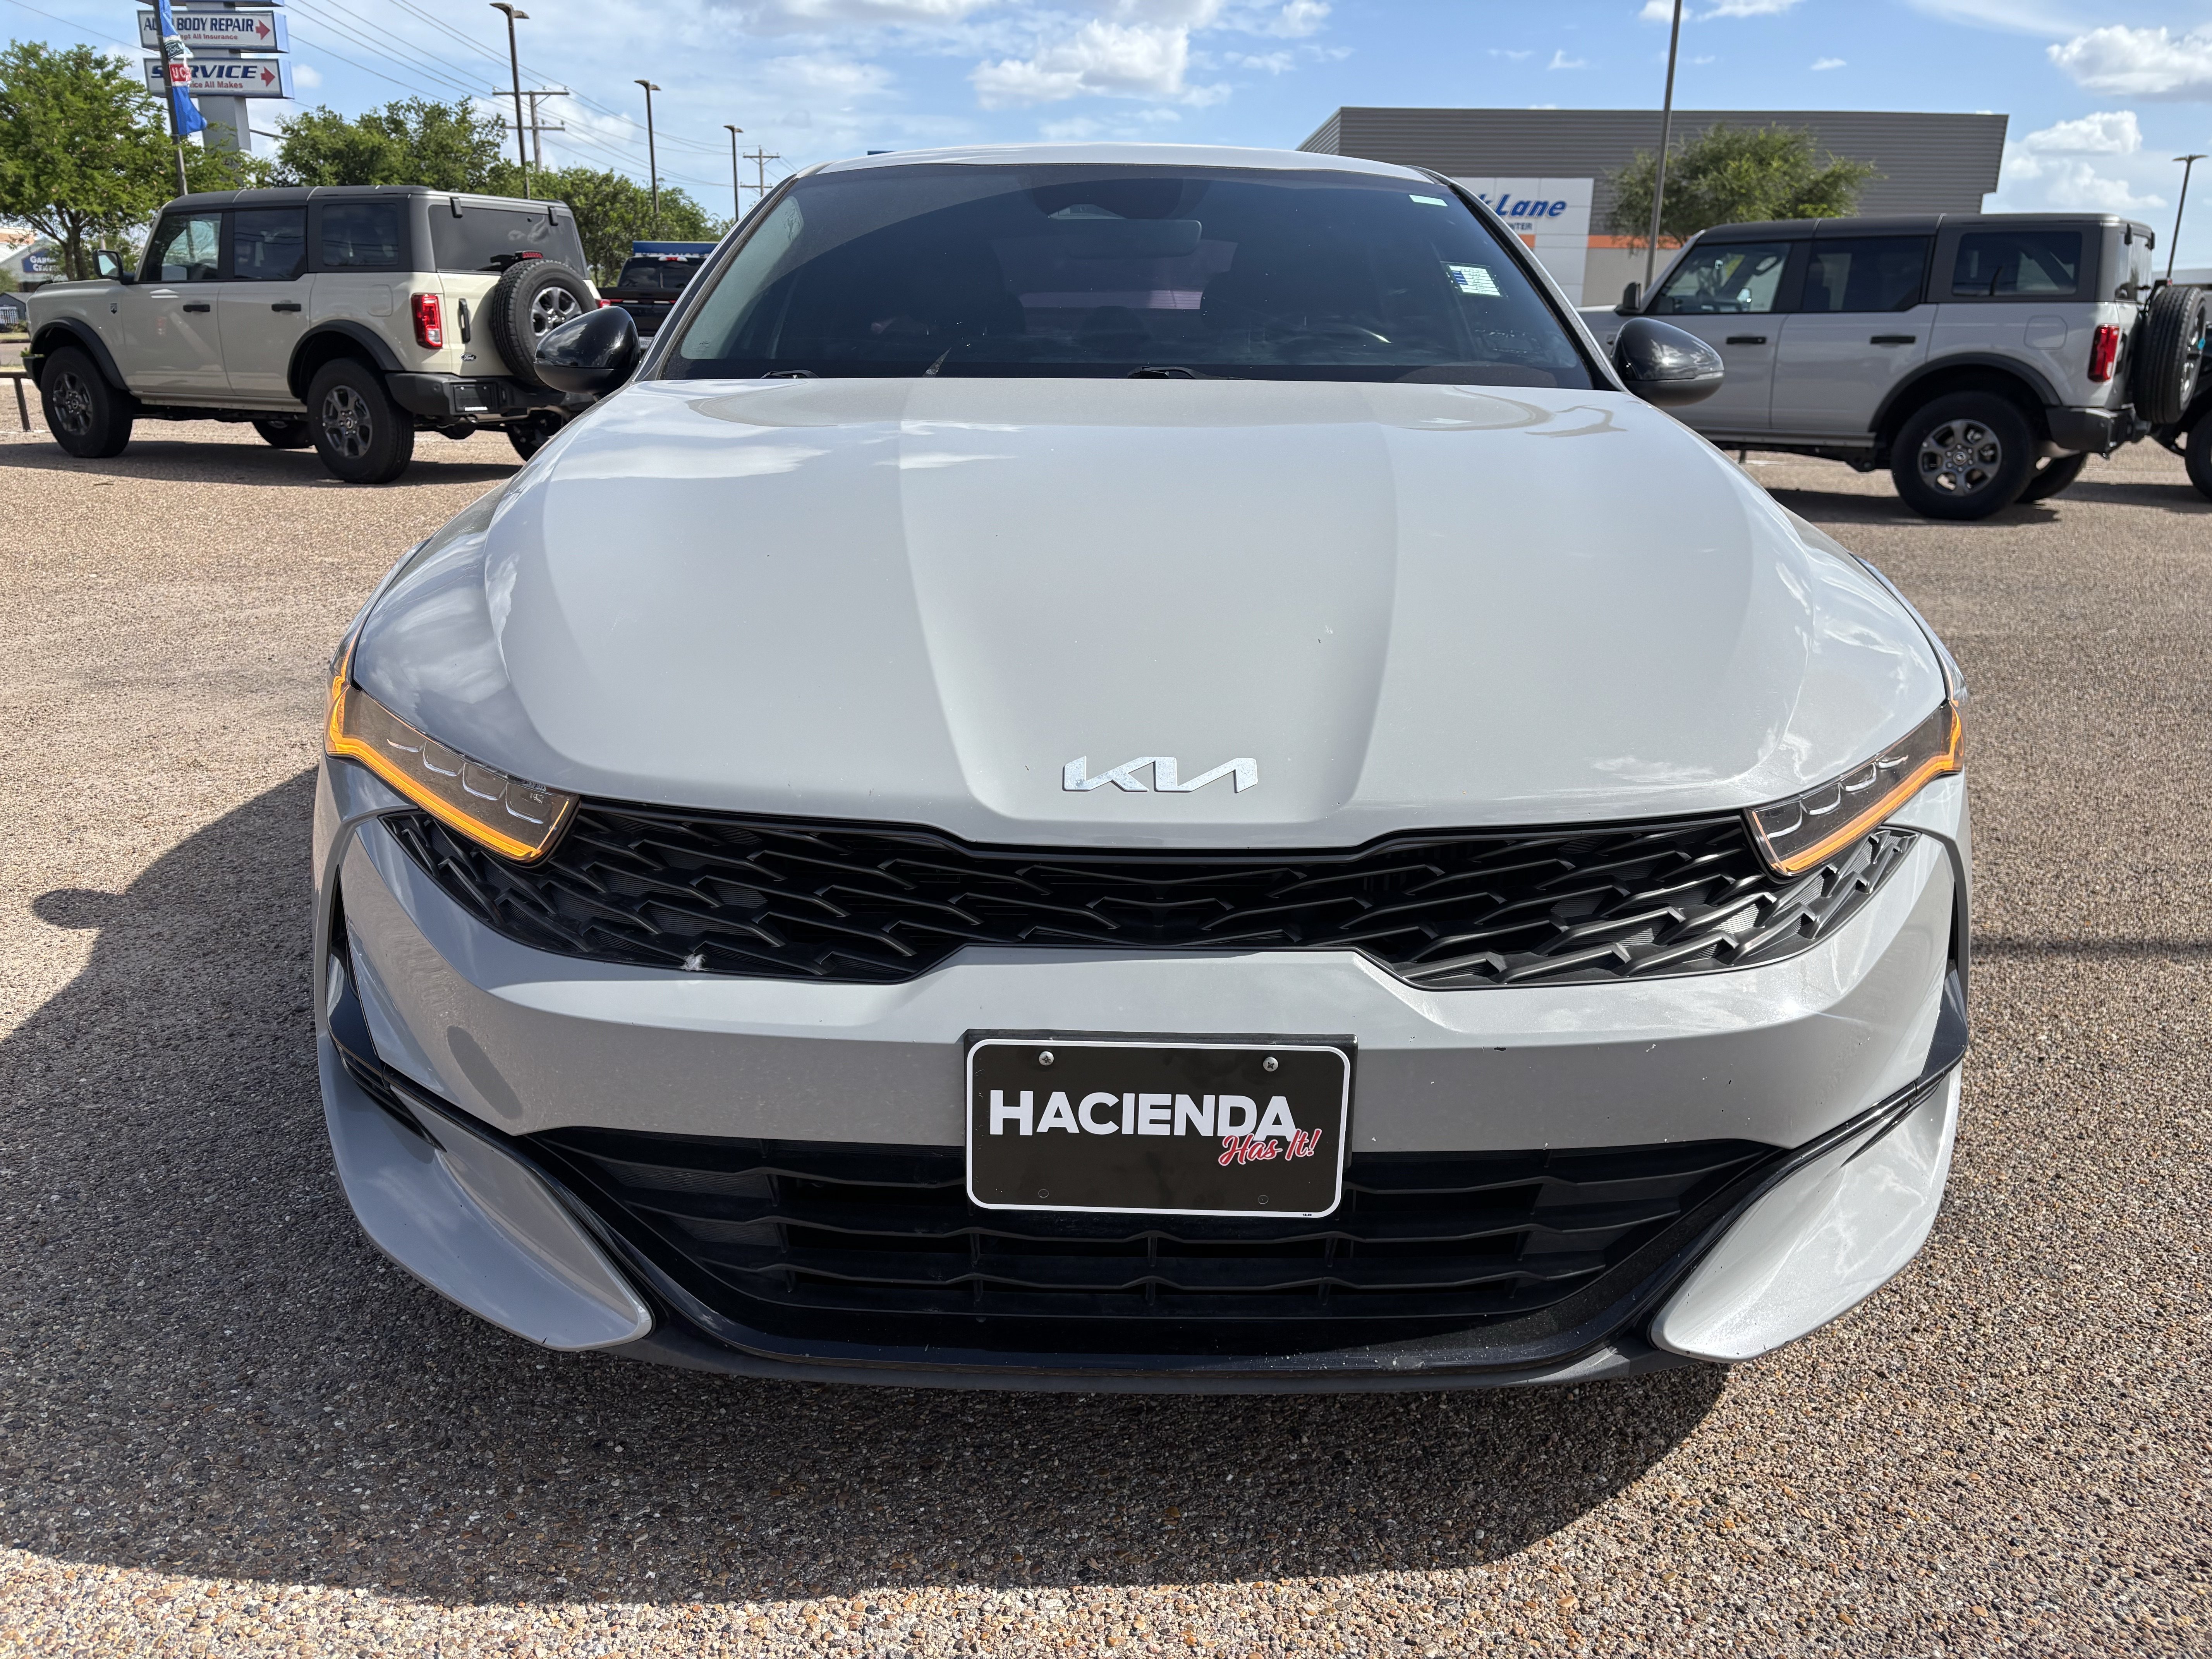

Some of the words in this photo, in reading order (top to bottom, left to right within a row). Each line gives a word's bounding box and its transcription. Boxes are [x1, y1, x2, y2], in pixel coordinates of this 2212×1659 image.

[177, 17, 208, 31] BODY
[210, 18, 254, 32] REPAIR
[151, 65, 258, 78] SRVICE
[1495, 194, 1567, 217] Lane
[990, 1090, 1297, 1142] HACIENDA
[1218, 1133, 1283, 1166] Has
[1285, 1128, 1322, 1161] It!
